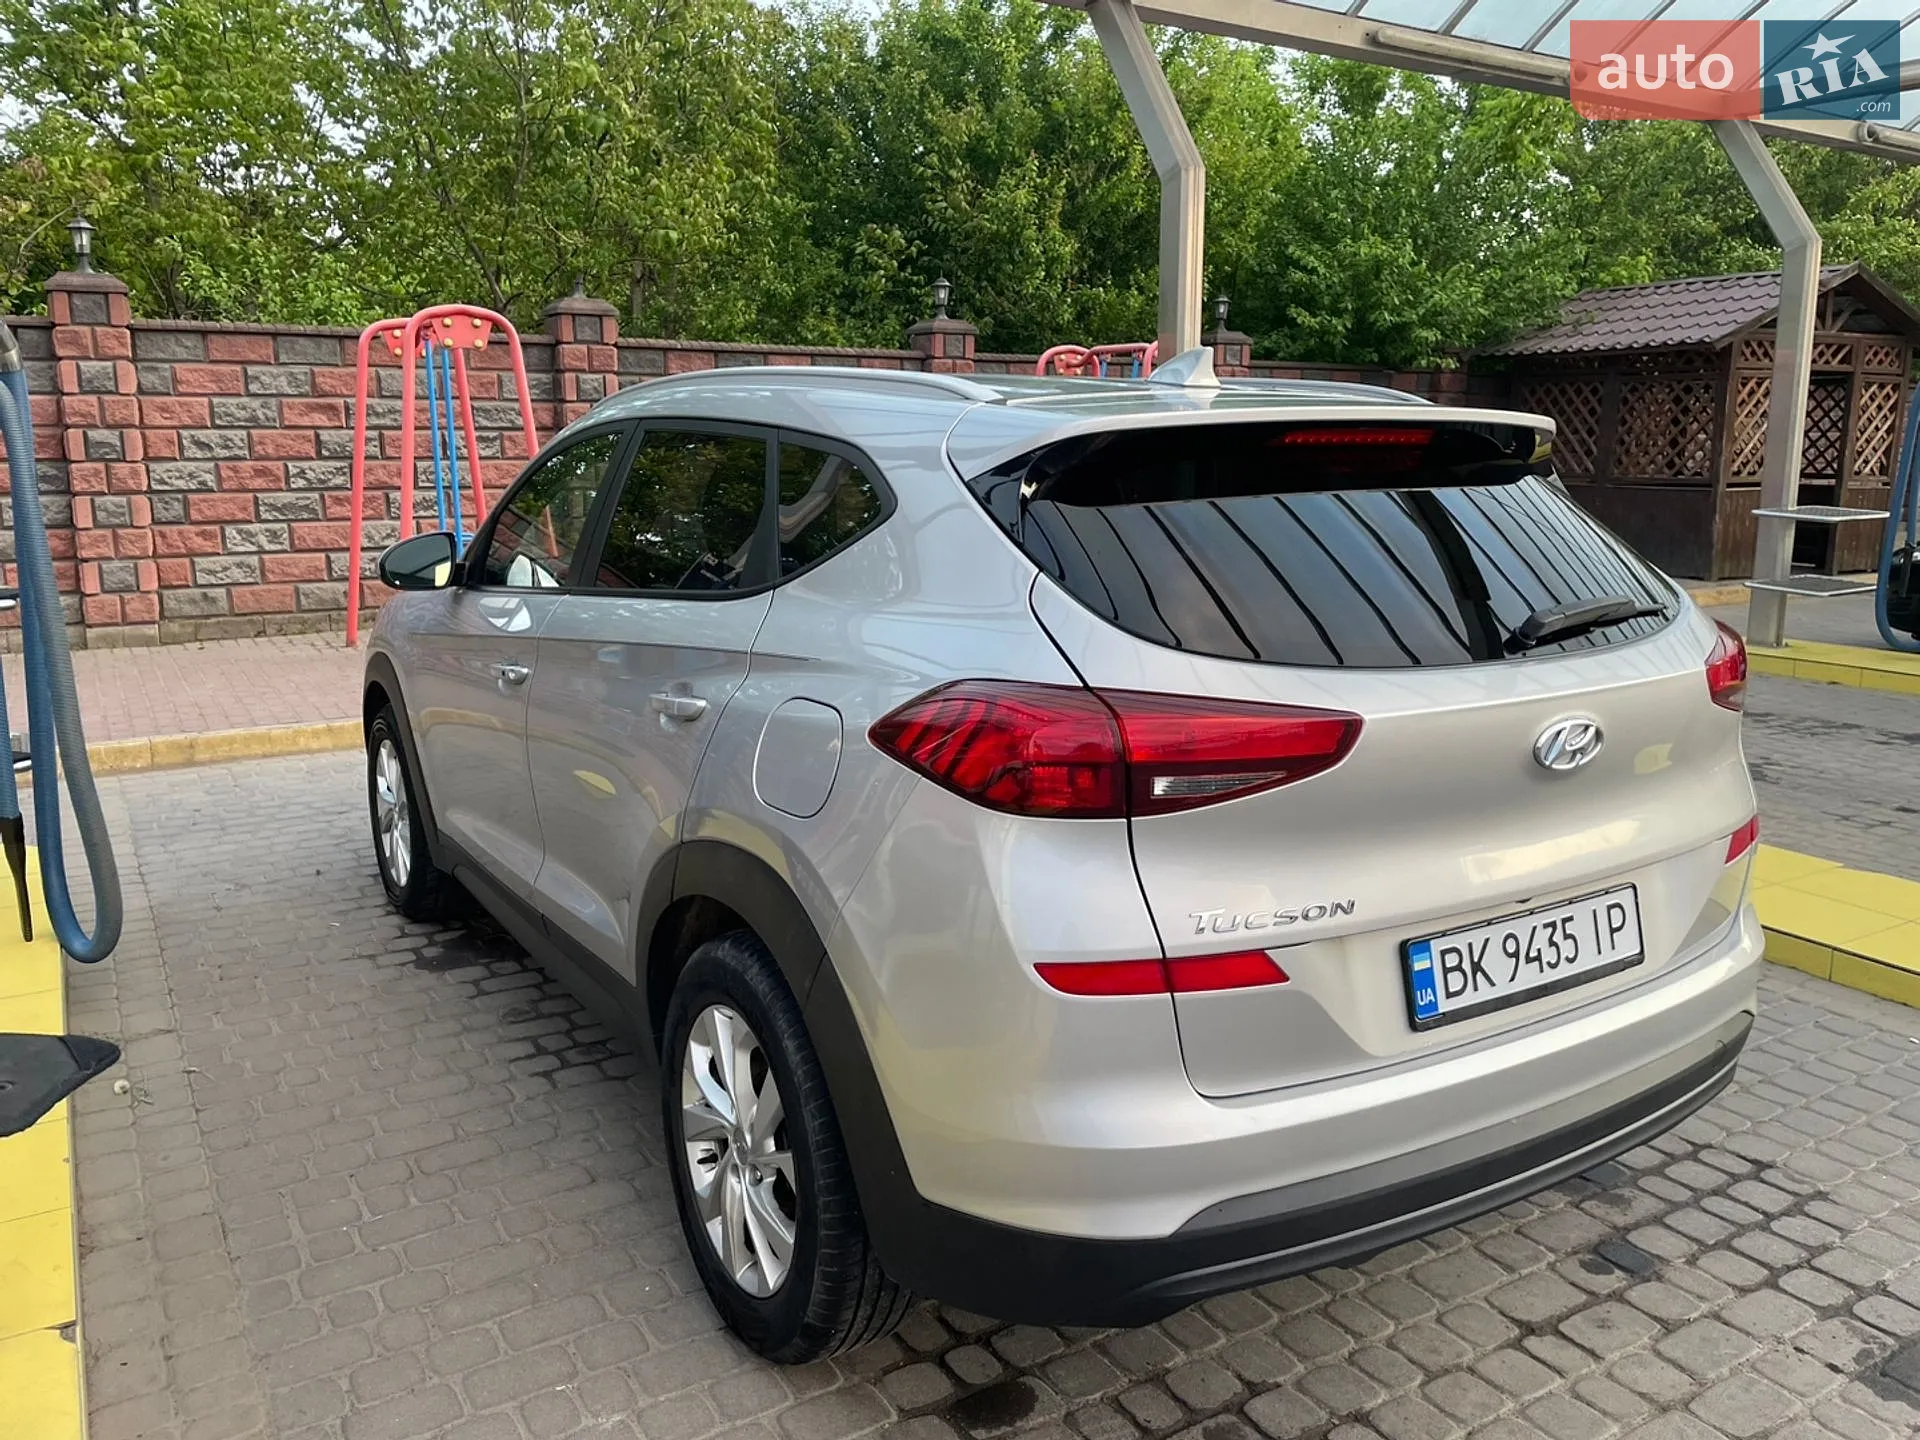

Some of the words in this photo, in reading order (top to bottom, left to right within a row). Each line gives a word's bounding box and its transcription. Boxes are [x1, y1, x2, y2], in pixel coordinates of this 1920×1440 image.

[1189, 899, 1356, 935] TUCSON
[1439, 936, 1497, 1000] BK
[1502, 914, 1580, 983] 9435
[1592, 901, 1627, 956] IP
[1417, 987, 1436, 1006] UA
